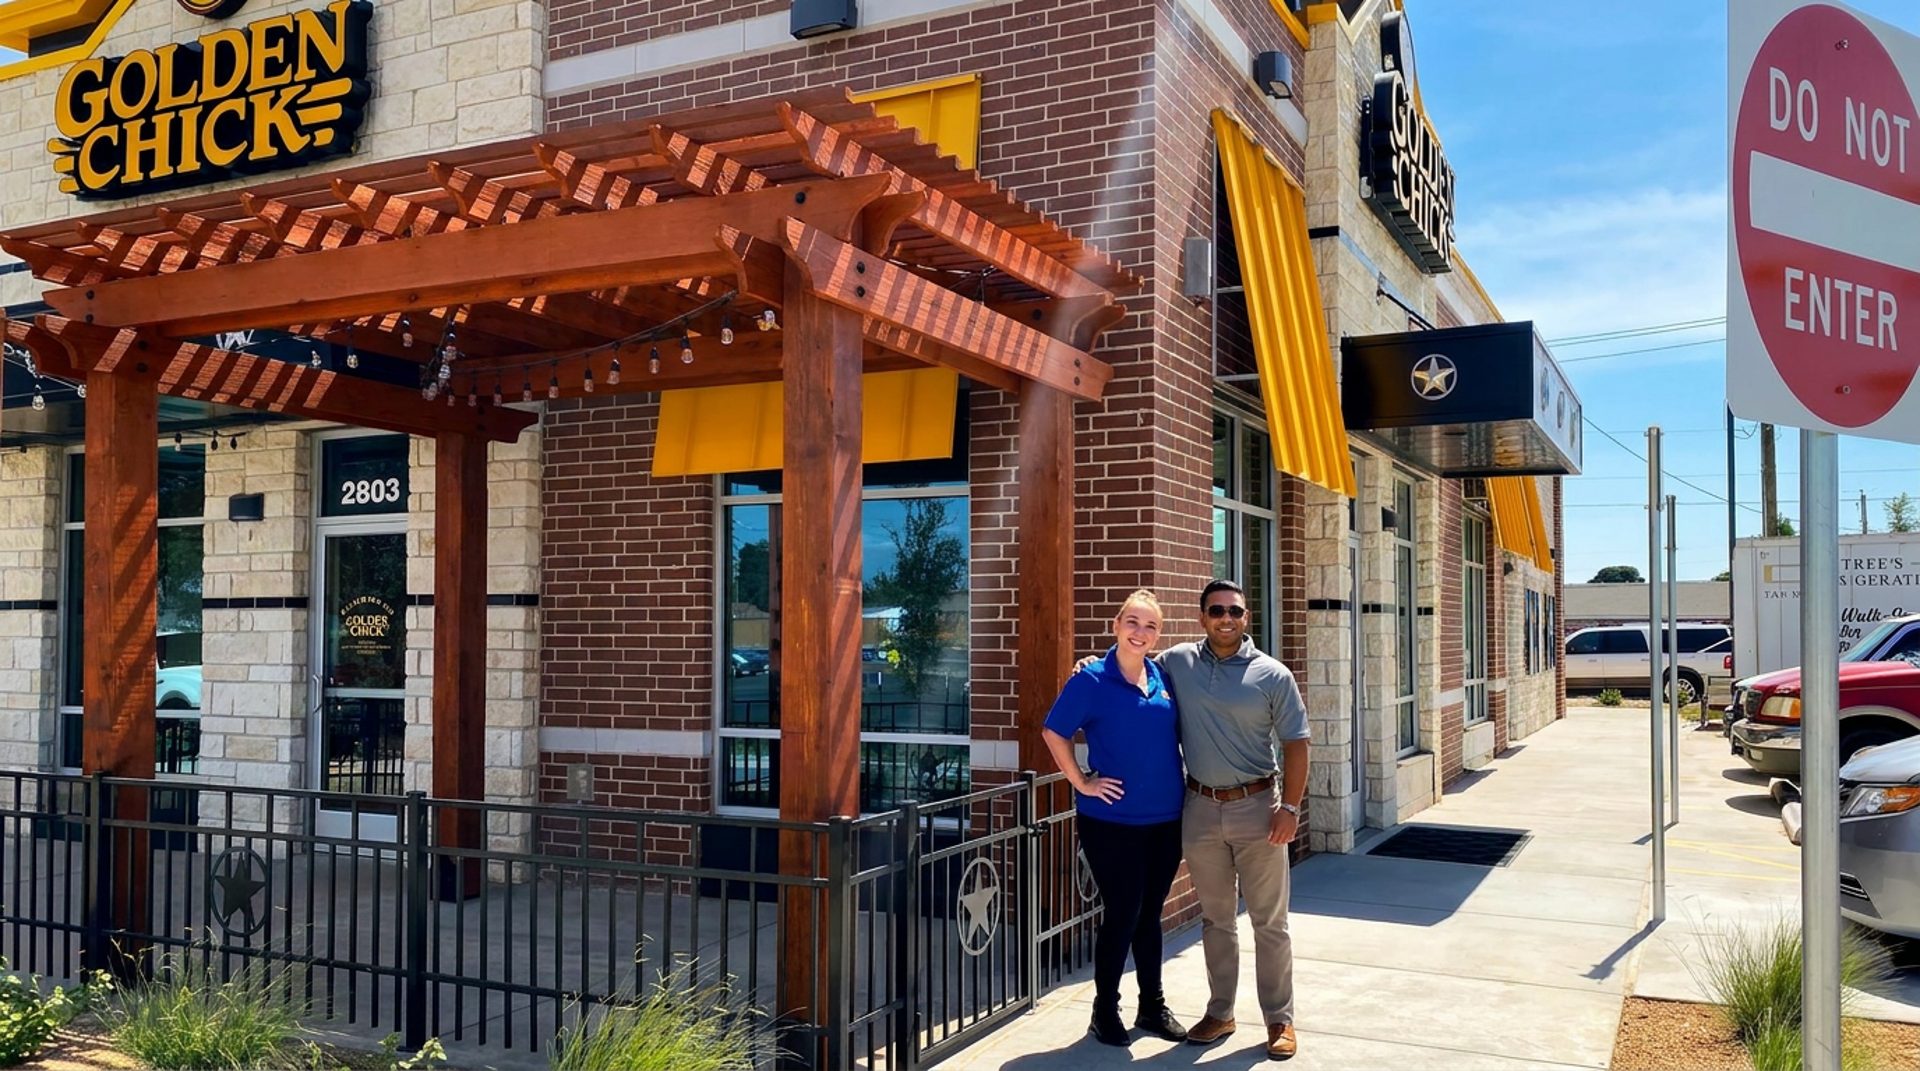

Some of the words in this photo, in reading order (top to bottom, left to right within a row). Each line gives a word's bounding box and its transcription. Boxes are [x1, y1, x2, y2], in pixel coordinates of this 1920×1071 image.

[54, 0, 350, 138] GOLDEN
[1768, 66, 1819, 142] DO
[1845, 96, 1911, 174] NOT
[78, 84, 311, 191] CHICK
[1391, 70, 1456, 224] GOLDEN
[1398, 151, 1452, 272] CHICK
[1784, 266, 1898, 351] ENTER
[341, 477, 400, 505] 2803
